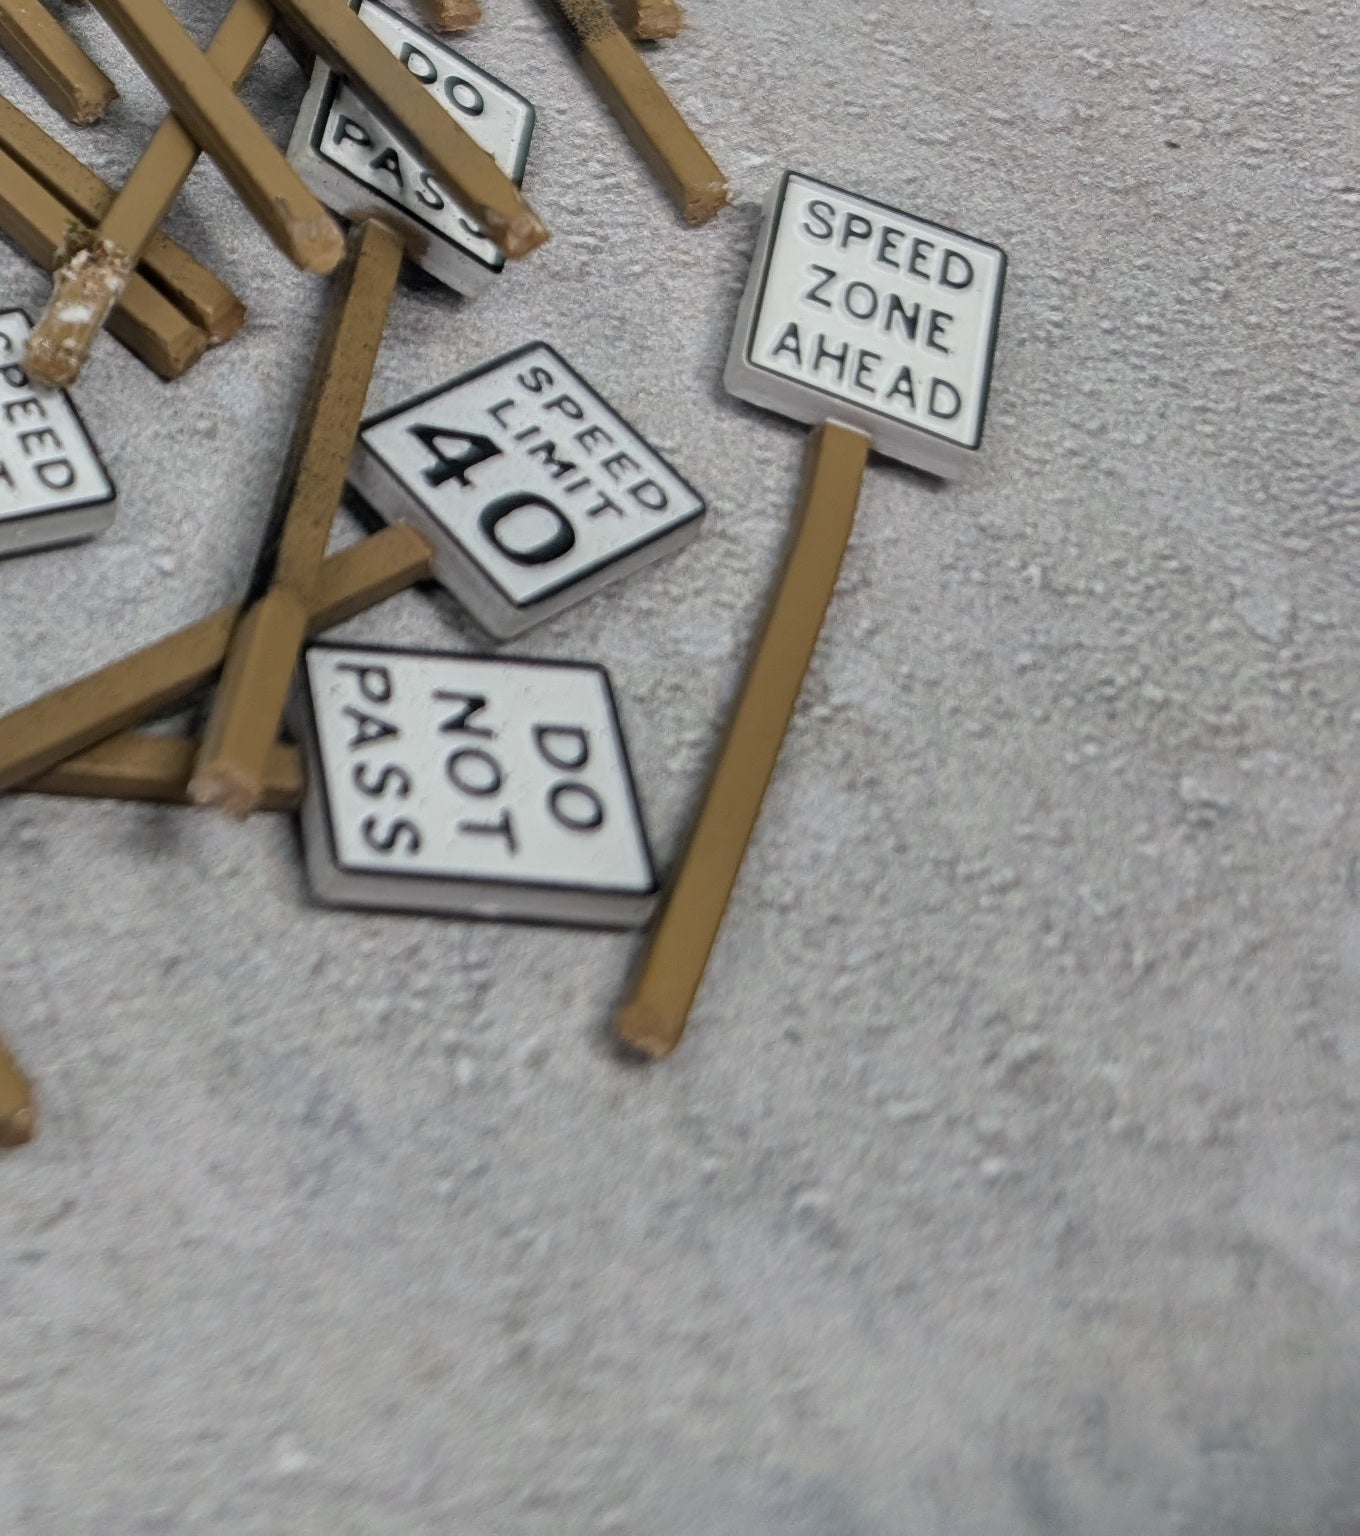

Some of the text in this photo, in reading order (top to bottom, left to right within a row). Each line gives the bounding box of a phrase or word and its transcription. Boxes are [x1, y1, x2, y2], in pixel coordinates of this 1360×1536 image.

[400, 42, 484, 116] DO
[333, 115, 490, 240] PAS
[803, 199, 975, 290] SPEED
[805, 264, 953, 354] ZONE
[773, 322, 961, 419] AHEAD
[407, 423, 576, 567] 40
[487, 398, 627, 520] LIMIT
[517, 366, 669, 513] SPEED
[337, 663, 420, 857] PASS
[433, 689, 518, 856] NOT
[532, 723, 605, 833] DO
